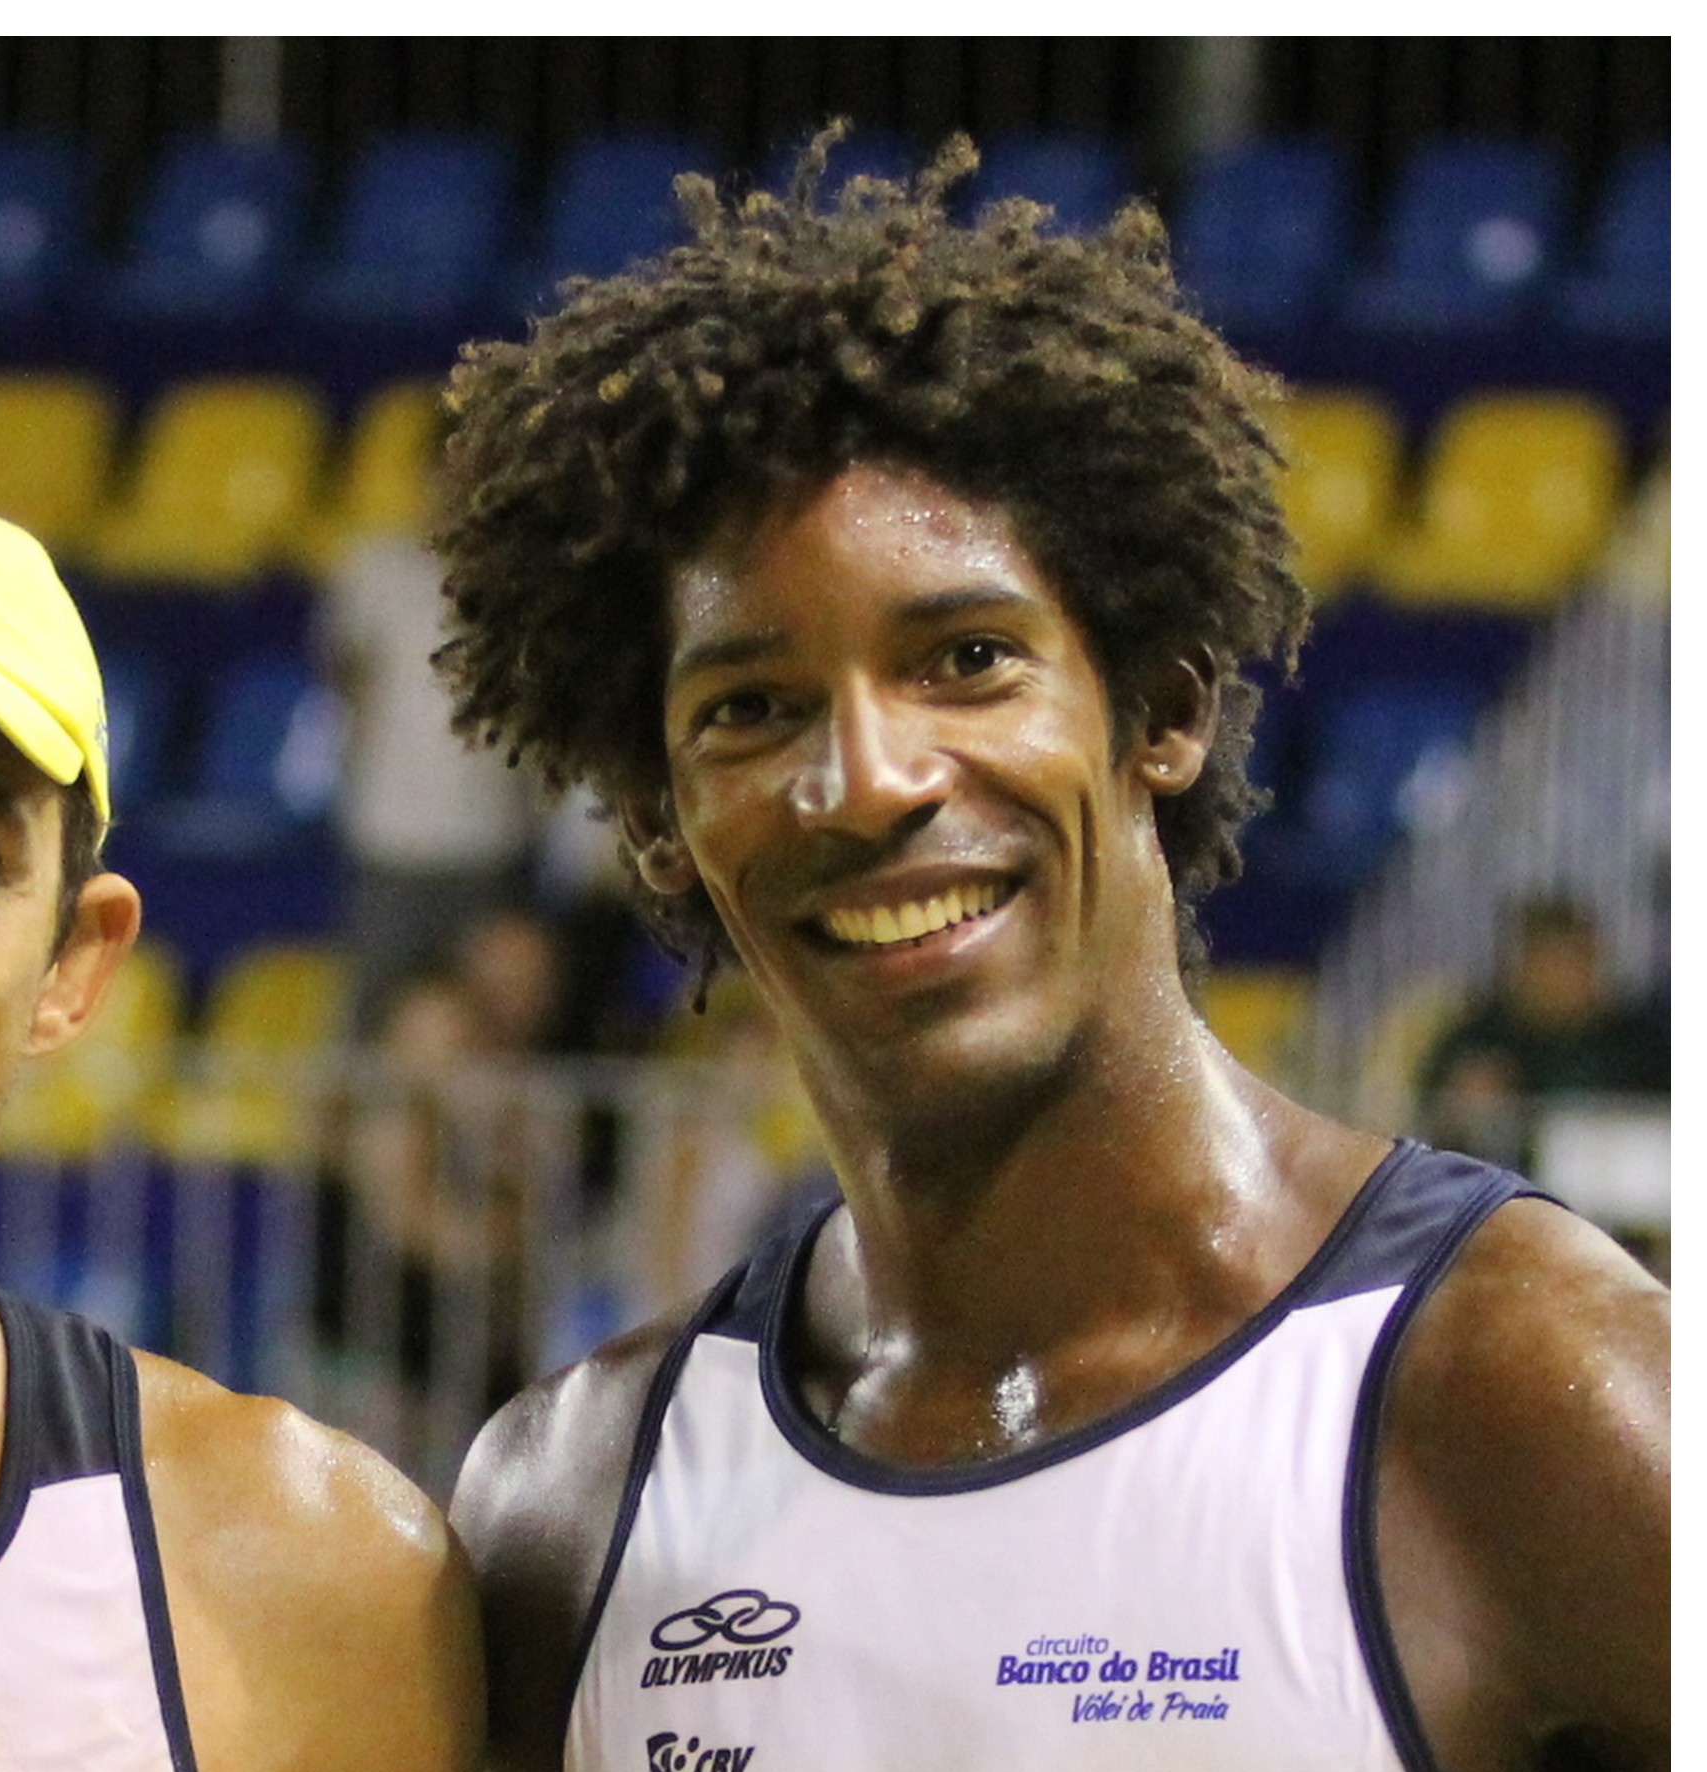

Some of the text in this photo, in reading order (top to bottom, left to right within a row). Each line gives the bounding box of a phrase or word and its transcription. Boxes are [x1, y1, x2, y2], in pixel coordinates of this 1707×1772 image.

[1026, 1634, 1110, 1656] circuito
[641, 1647, 793, 1688] OLYMPIKUS
[996, 1648, 1240, 1685] Banco do Brasil
[1127, 1690, 1153, 1721] de
[1160, 1691, 1230, 1722] Praia
